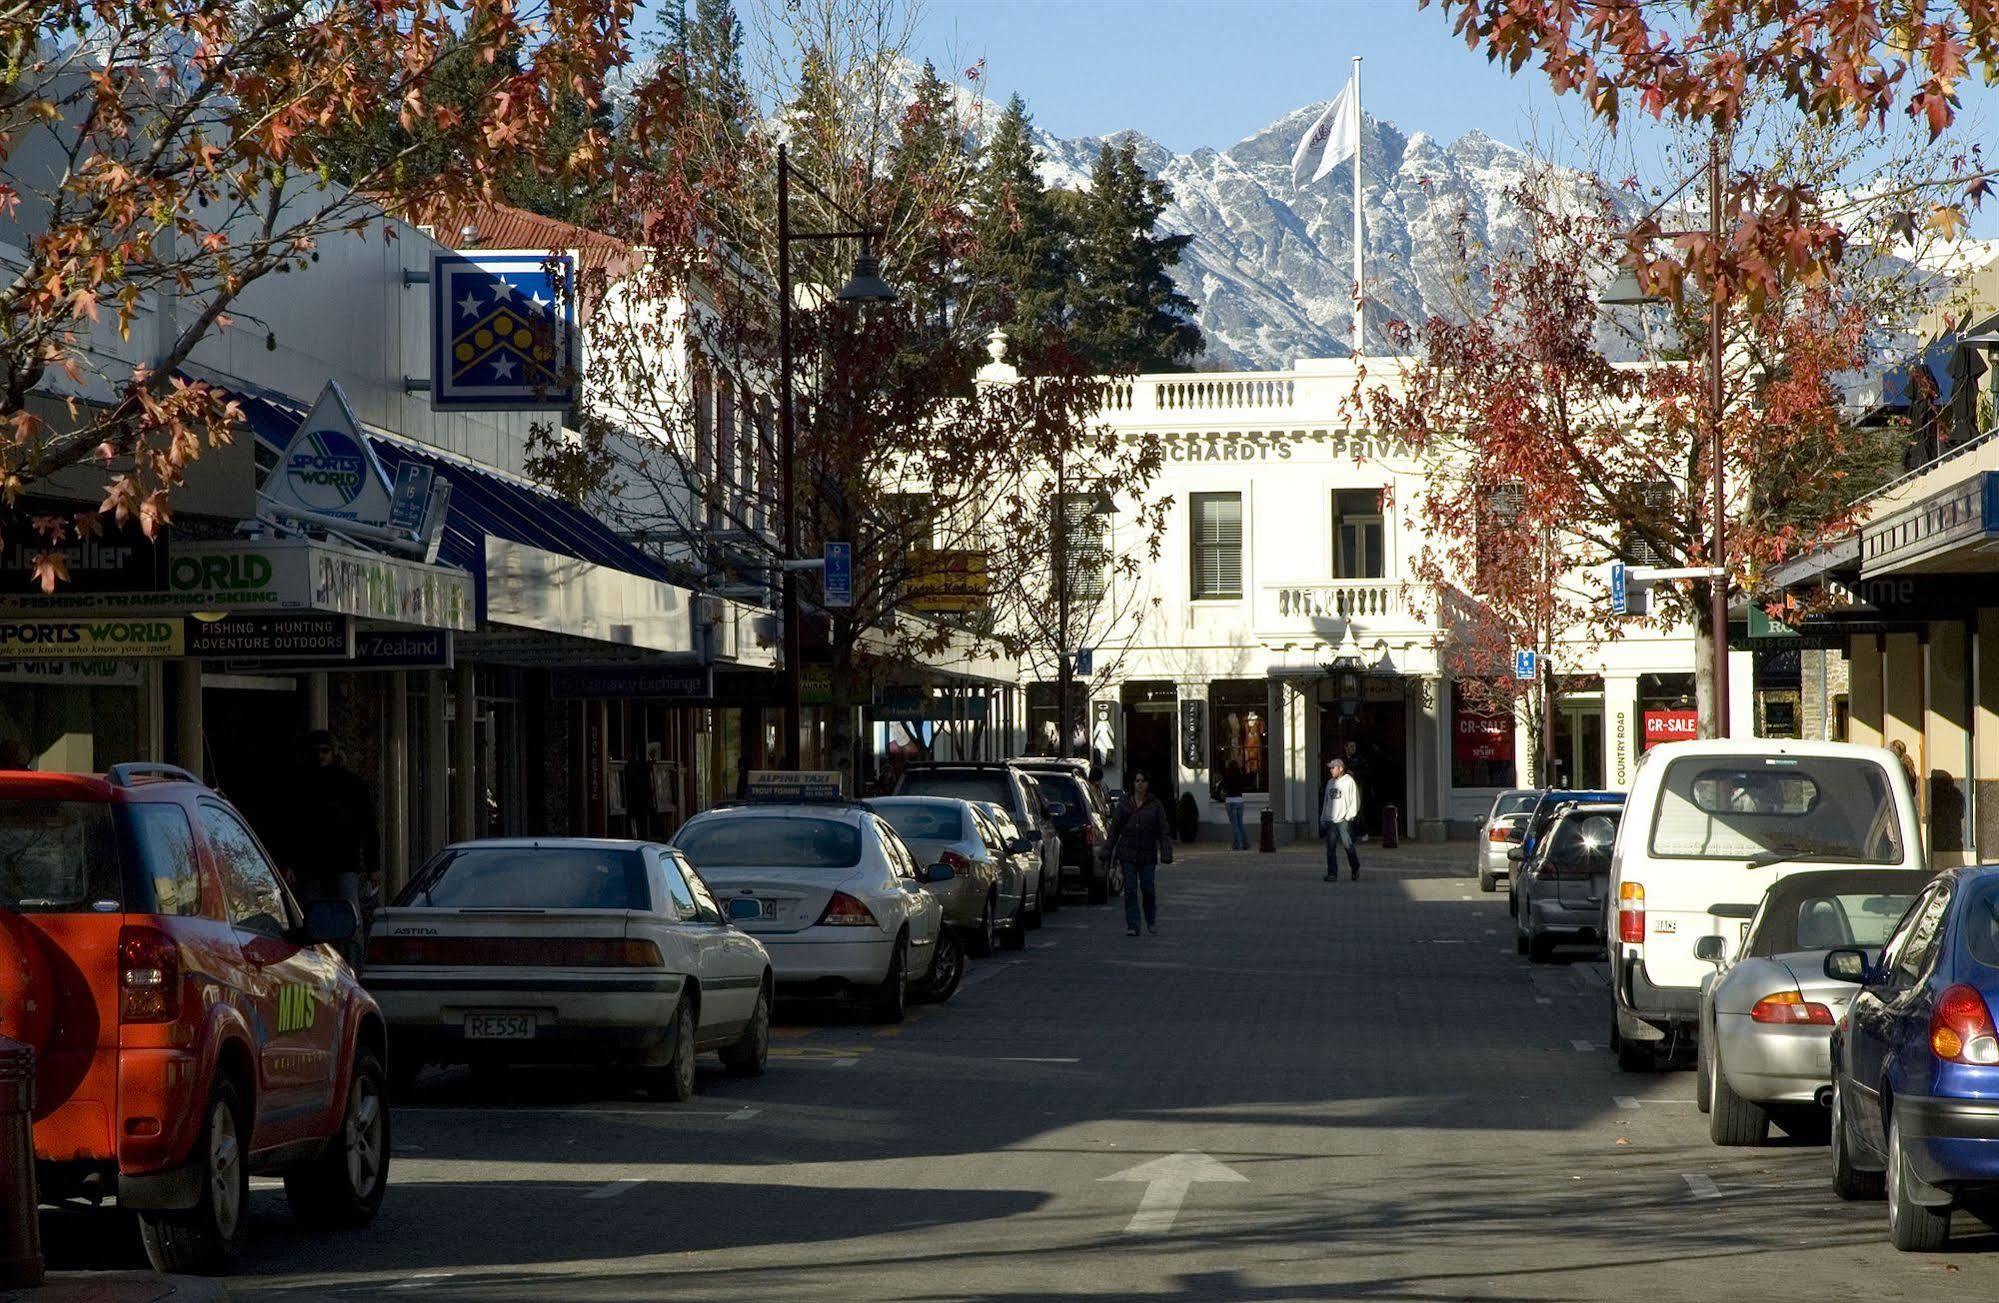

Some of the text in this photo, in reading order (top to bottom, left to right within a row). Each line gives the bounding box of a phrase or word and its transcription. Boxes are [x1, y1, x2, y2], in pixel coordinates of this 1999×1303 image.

[1160, 443, 1291, 462] ICHARDT'S
[291, 454, 361, 471] SPORTS
[296, 470, 359, 486] WORLD
[409, 466, 420, 482] P
[169, 555, 272, 591] ORLD
[104, 594, 206, 606] TRAMPING
[213, 591, 278, 604] SKIING
[0, 622, 172, 643] PORTS WORLD
[202, 620, 333, 634] FISHING HUNTING
[18, 647, 35, 655] you
[38, 645, 64, 654] know
[68, 645, 88, 654] who
[92, 645, 118, 653] know
[121, 646, 145, 655] your
[147, 645, 171, 655] sport
[192, 636, 343, 650] ADVENTURE OUTDOORS
[373, 637, 438, 656] Zealand
[641, 677, 703, 694] Exchange
[1460, 720, 1507, 734] CR-SALE
[1646, 718, 1696, 733] CR-SALE
[1617, 712, 1625, 786] COUNTRY ROAD
[758, 774, 830, 783] ALPINE TAXI
[393, 927, 439, 935] ASTINA
[278, 983, 316, 1033] MMS
[471, 1016, 529, 1037] RE554
